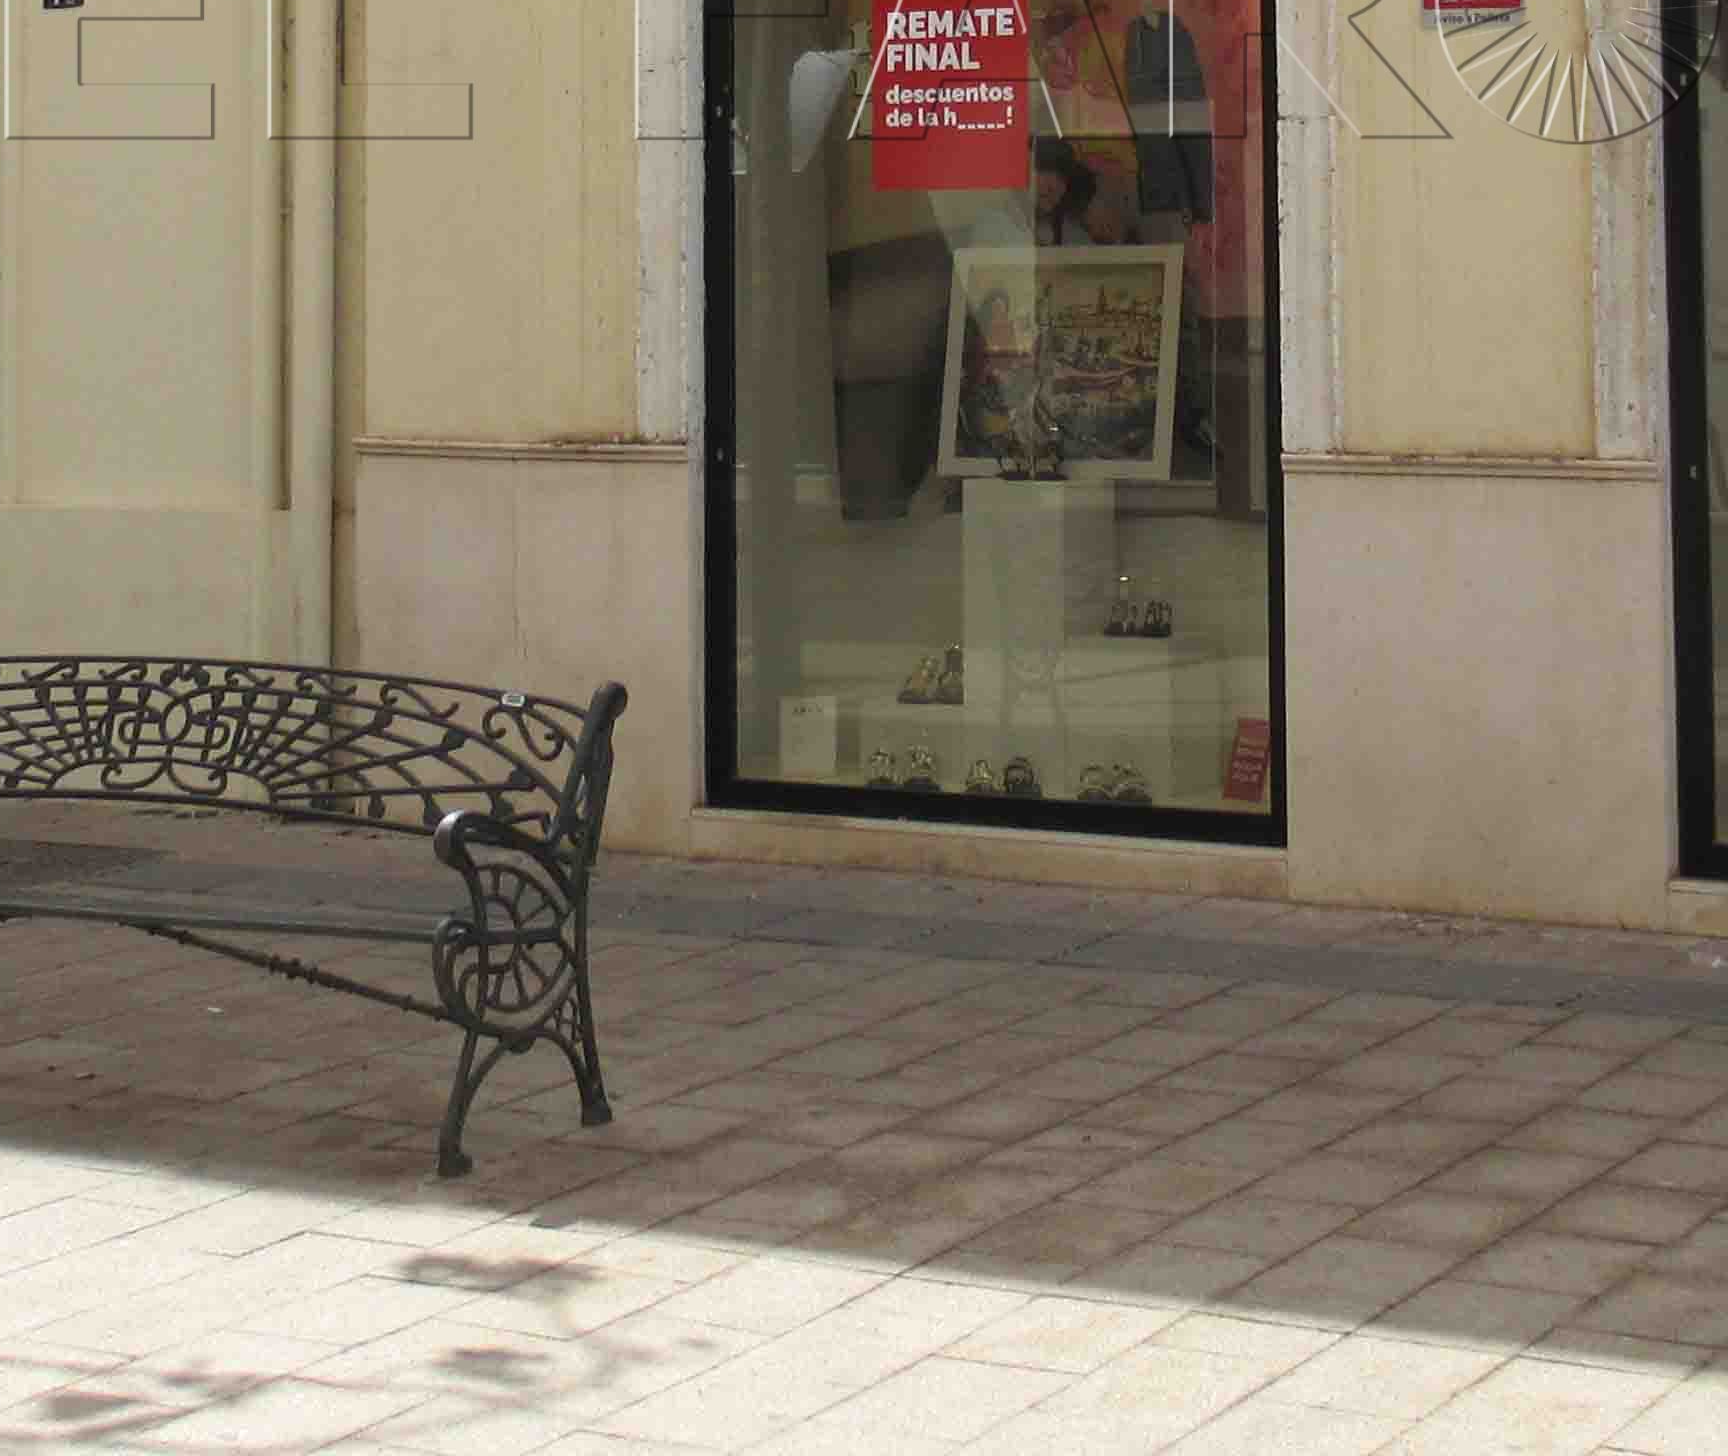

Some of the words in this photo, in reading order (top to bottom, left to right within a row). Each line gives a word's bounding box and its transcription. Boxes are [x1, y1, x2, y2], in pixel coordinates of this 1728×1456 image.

[887, 8, 1014, 40] REMATE
[887, 42, 981, 72] FINAL
[885, 83, 1015, 105] descuentos
[885, 108, 913, 127] de
[918, 107, 939, 127] la
